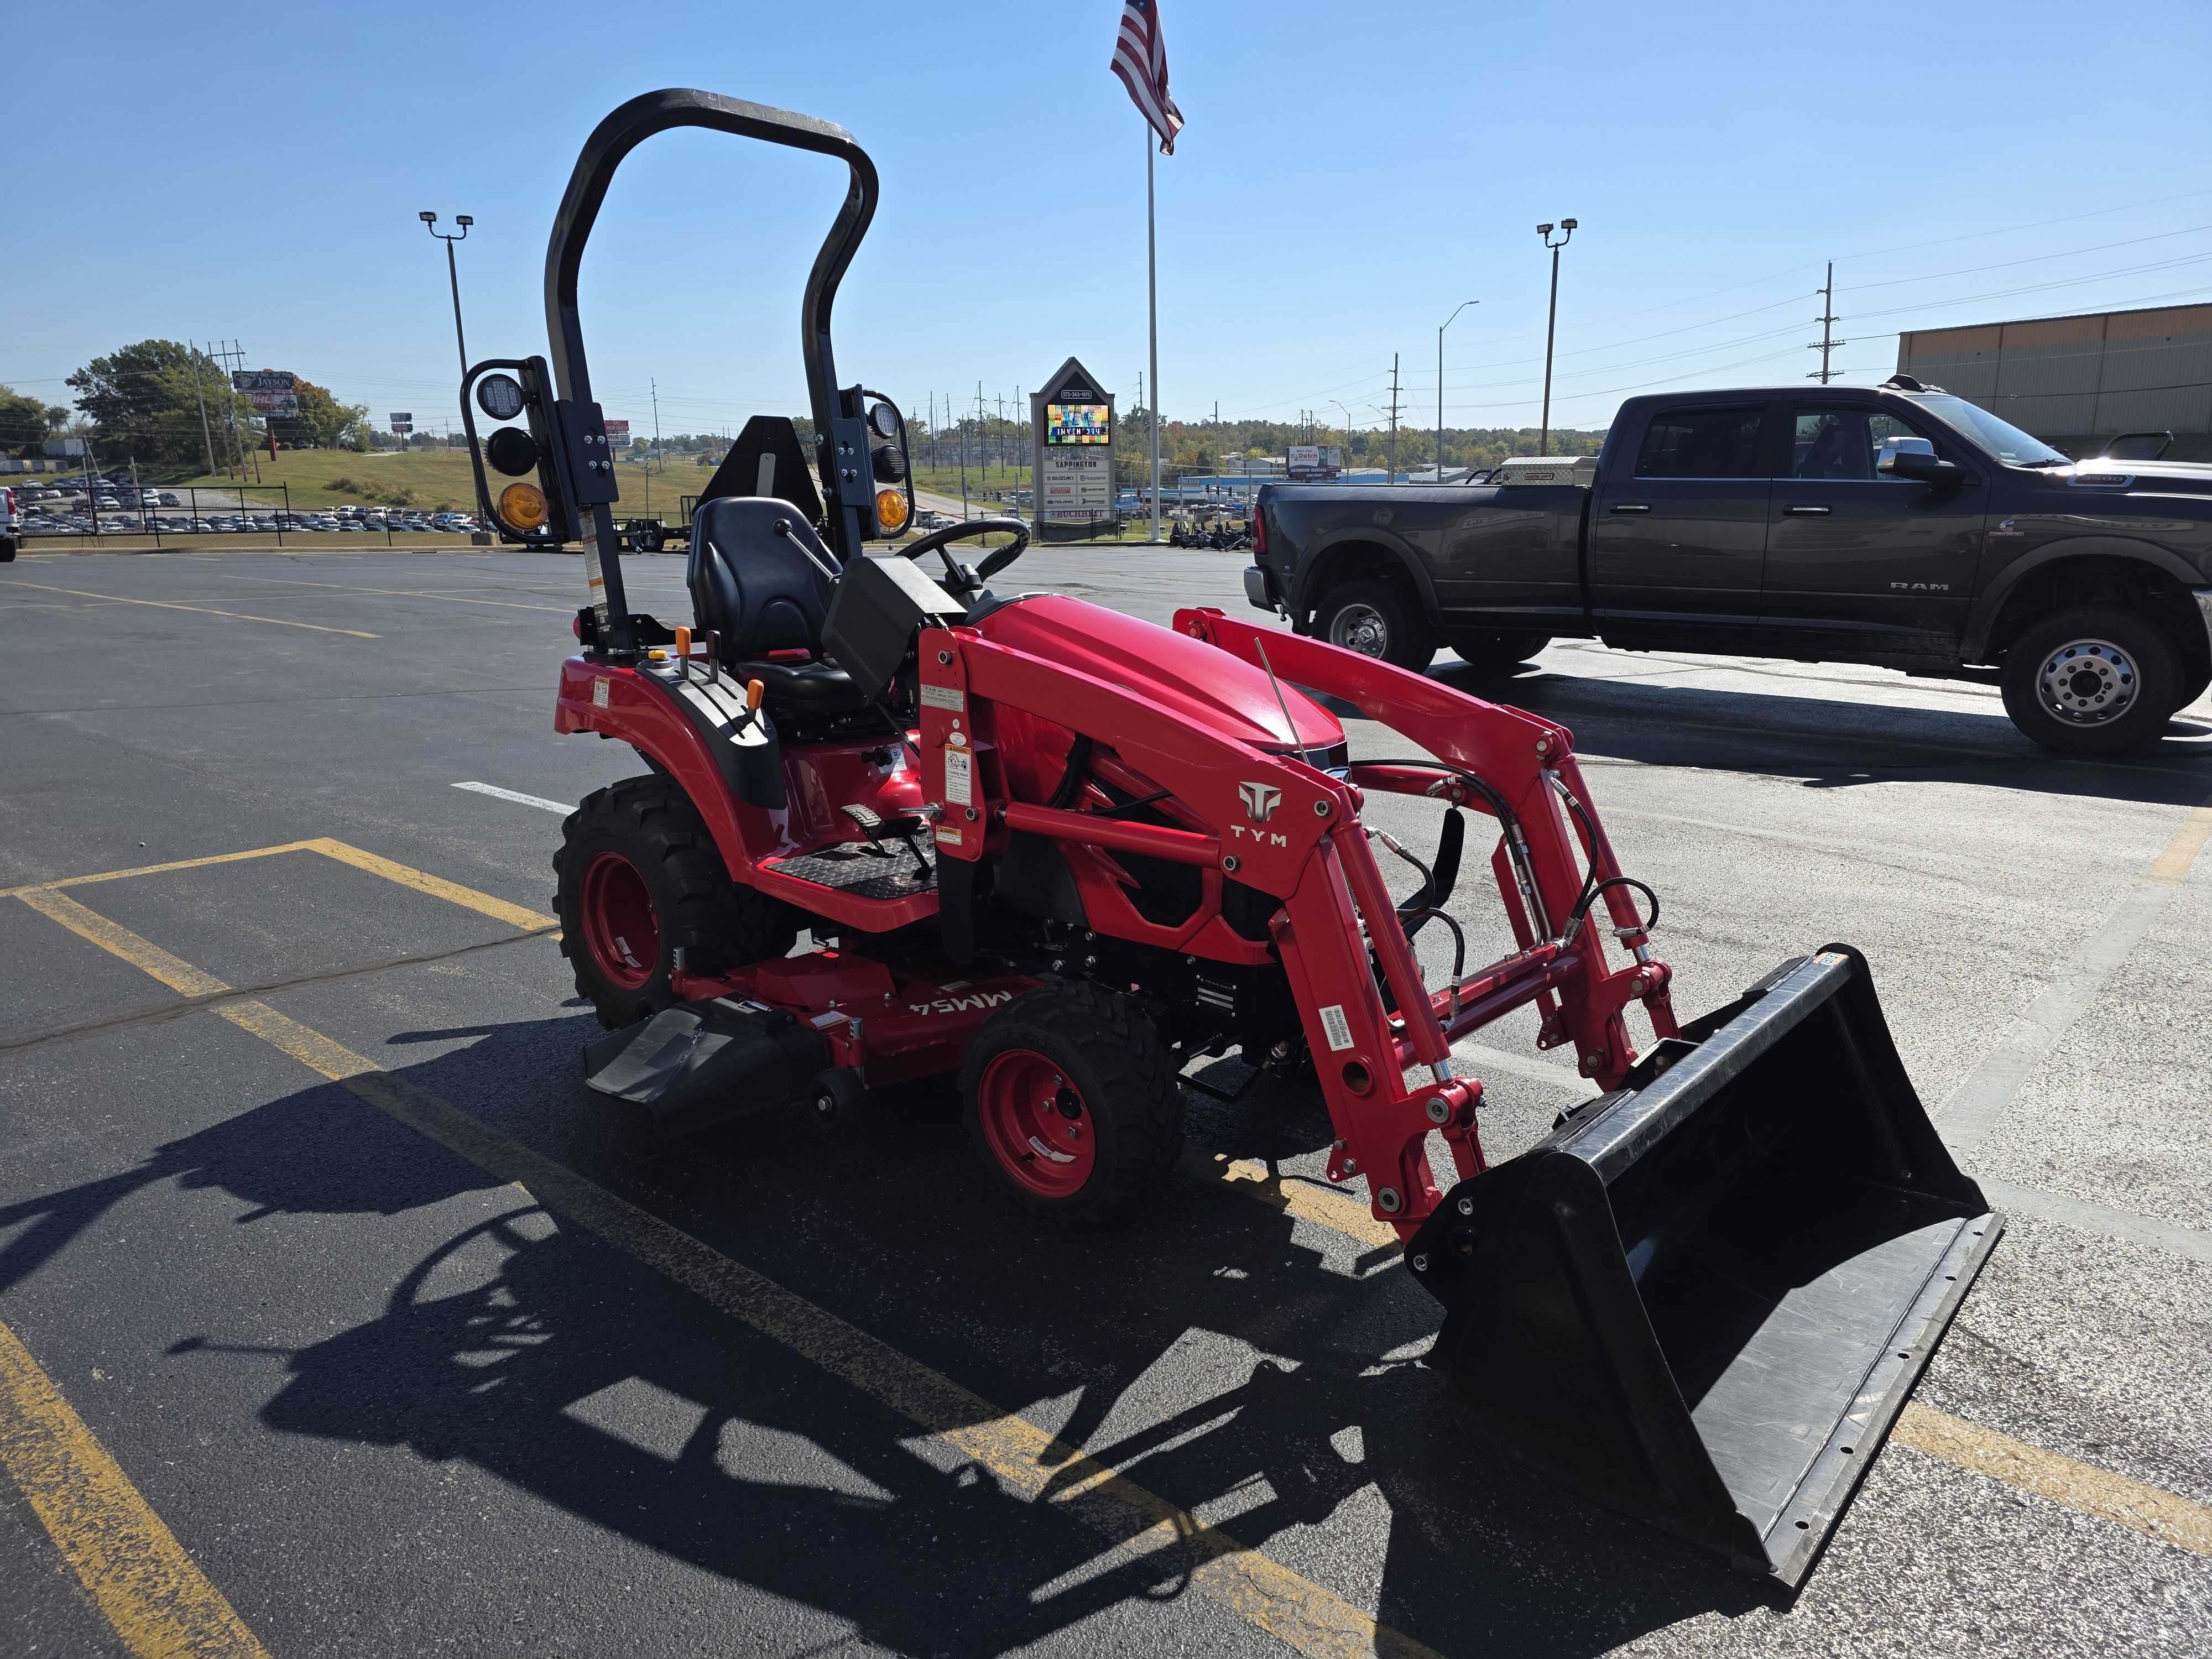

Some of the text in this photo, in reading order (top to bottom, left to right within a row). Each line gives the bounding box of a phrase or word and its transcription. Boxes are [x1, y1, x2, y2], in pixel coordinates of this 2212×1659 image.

[257, 377, 290, 387] JAYSON
[1057, 510, 1103, 518] BUCHHEIT
[1230, 825, 1286, 847] TYM
[909, 990, 1013, 1016] MM54
